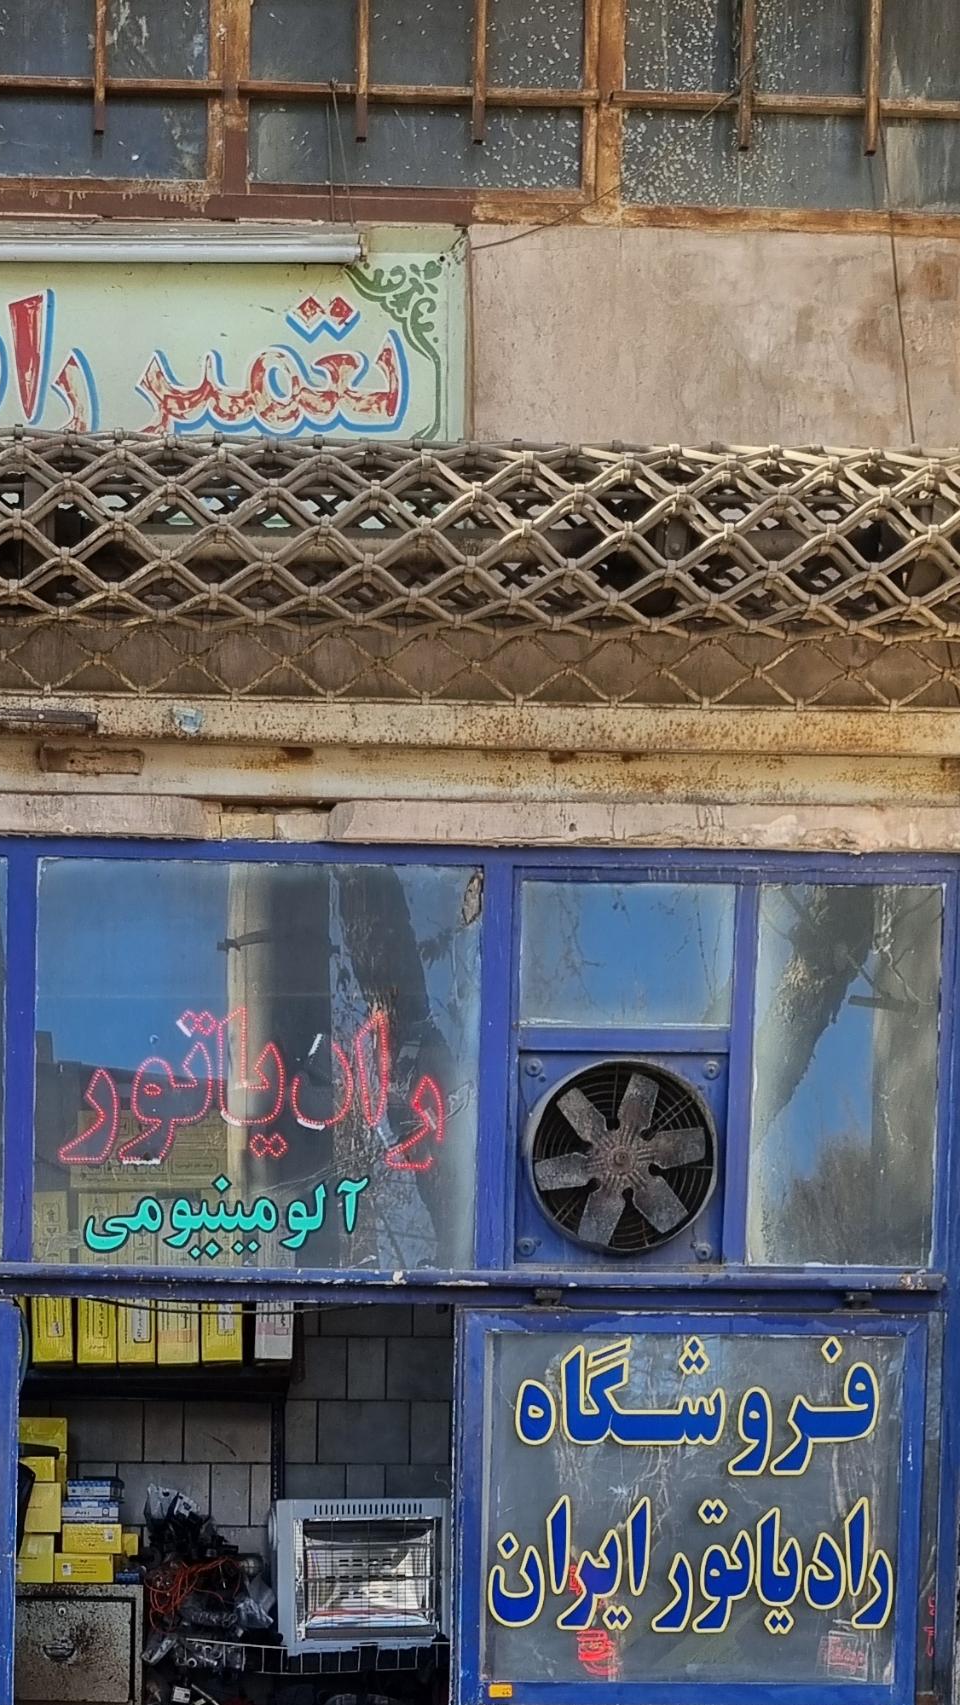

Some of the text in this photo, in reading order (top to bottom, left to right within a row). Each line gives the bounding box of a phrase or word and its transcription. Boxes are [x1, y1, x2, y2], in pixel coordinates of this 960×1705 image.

[58, 1003, 444, 1170] رادیاتور
[83, 1174, 371, 1260] آلومینیومی
[515, 1335, 881, 1476] فروشگاه
[487, 1495, 893, 1635] رادیاتور ایران
